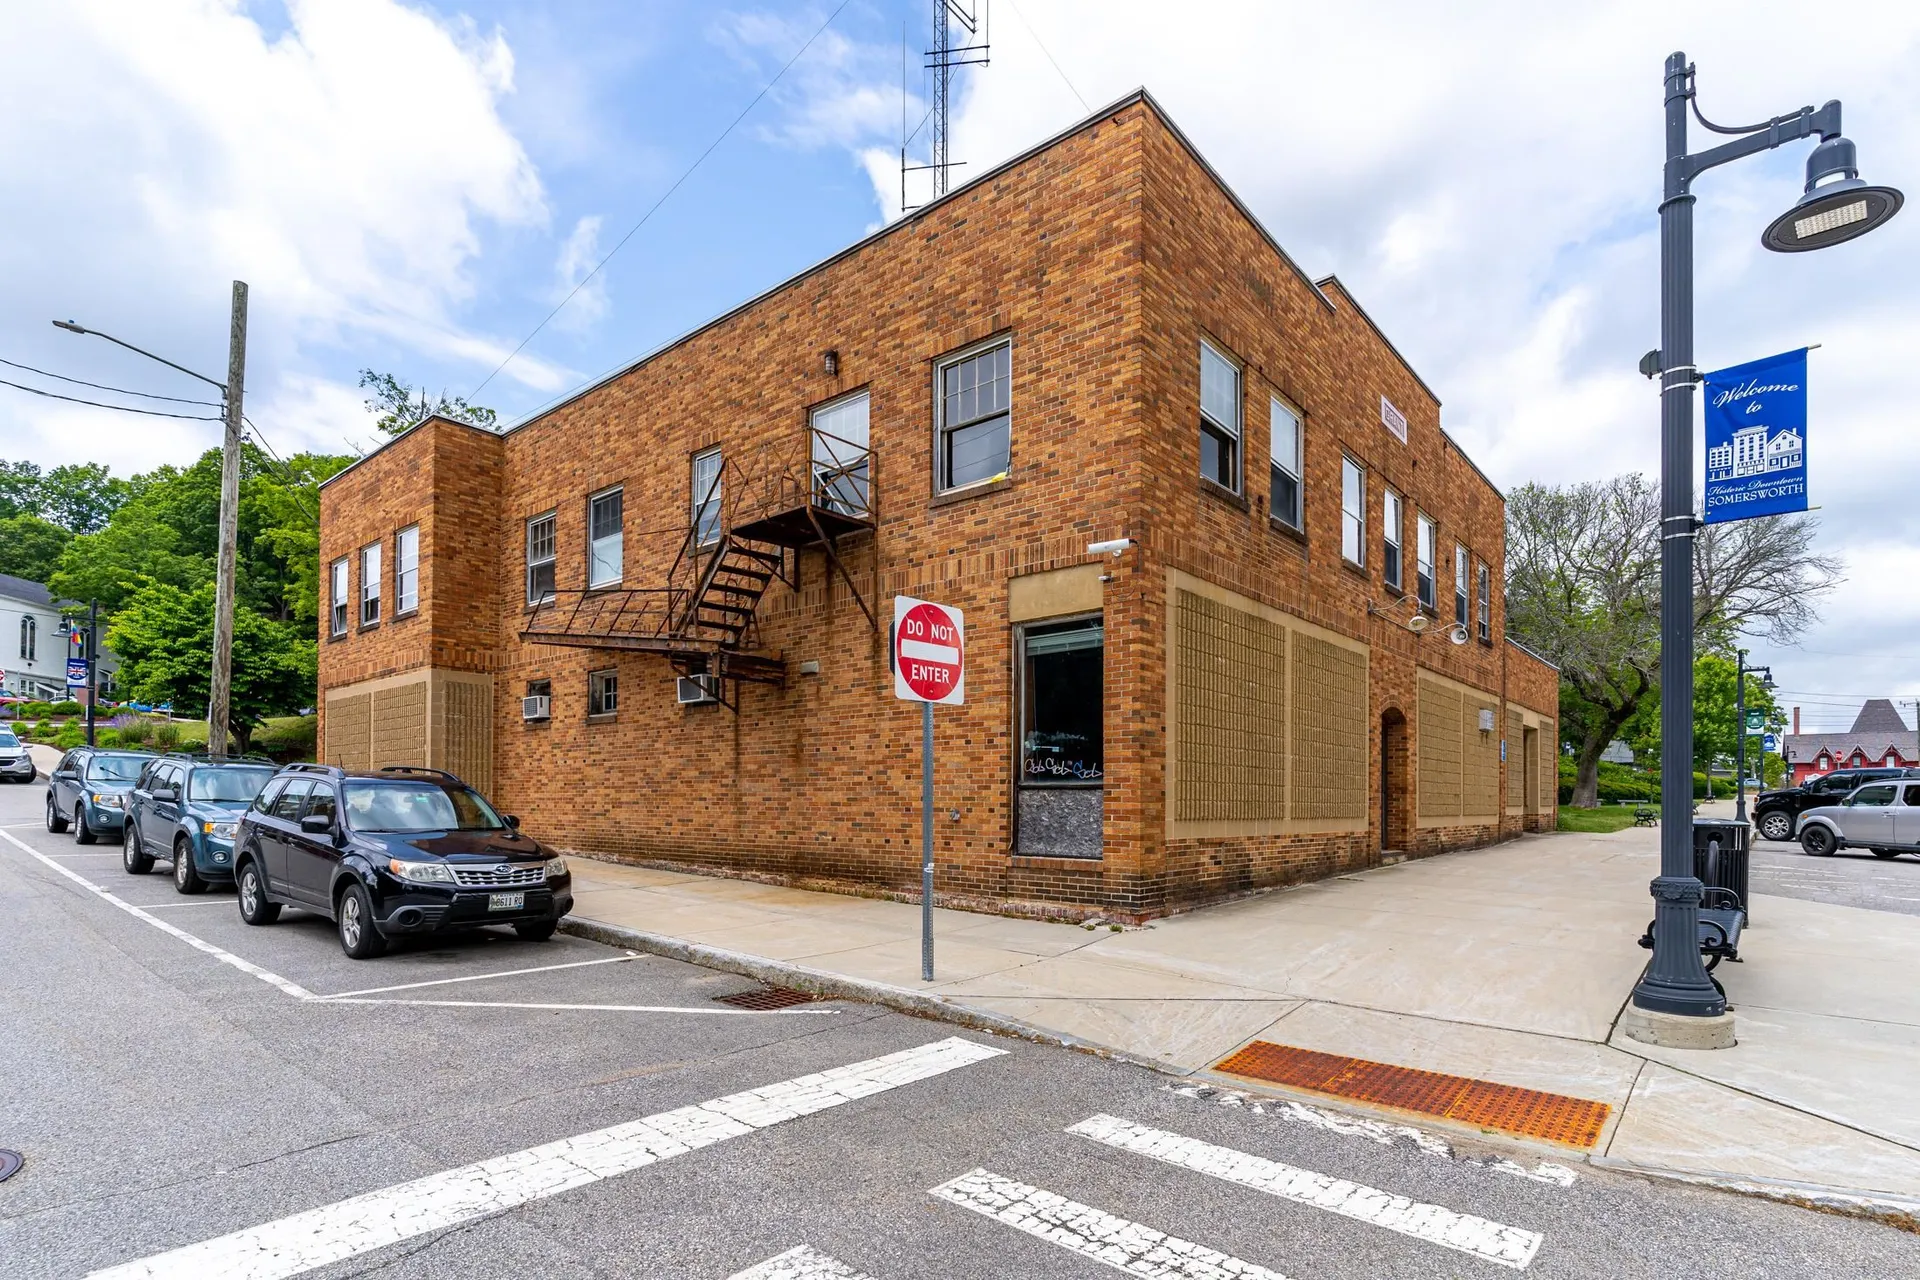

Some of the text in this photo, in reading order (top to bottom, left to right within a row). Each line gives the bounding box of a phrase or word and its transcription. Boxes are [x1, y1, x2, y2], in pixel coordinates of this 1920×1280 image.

[1712, 378, 1799, 408] Welcome
[1745, 400, 1763, 414] to
[1707, 476, 1803, 496] Historic Downtown
[1708, 483, 1803, 507] SOMERSWORTH
[907, 619, 954, 641] DO NOT
[911, 664, 950, 684] ENTER
